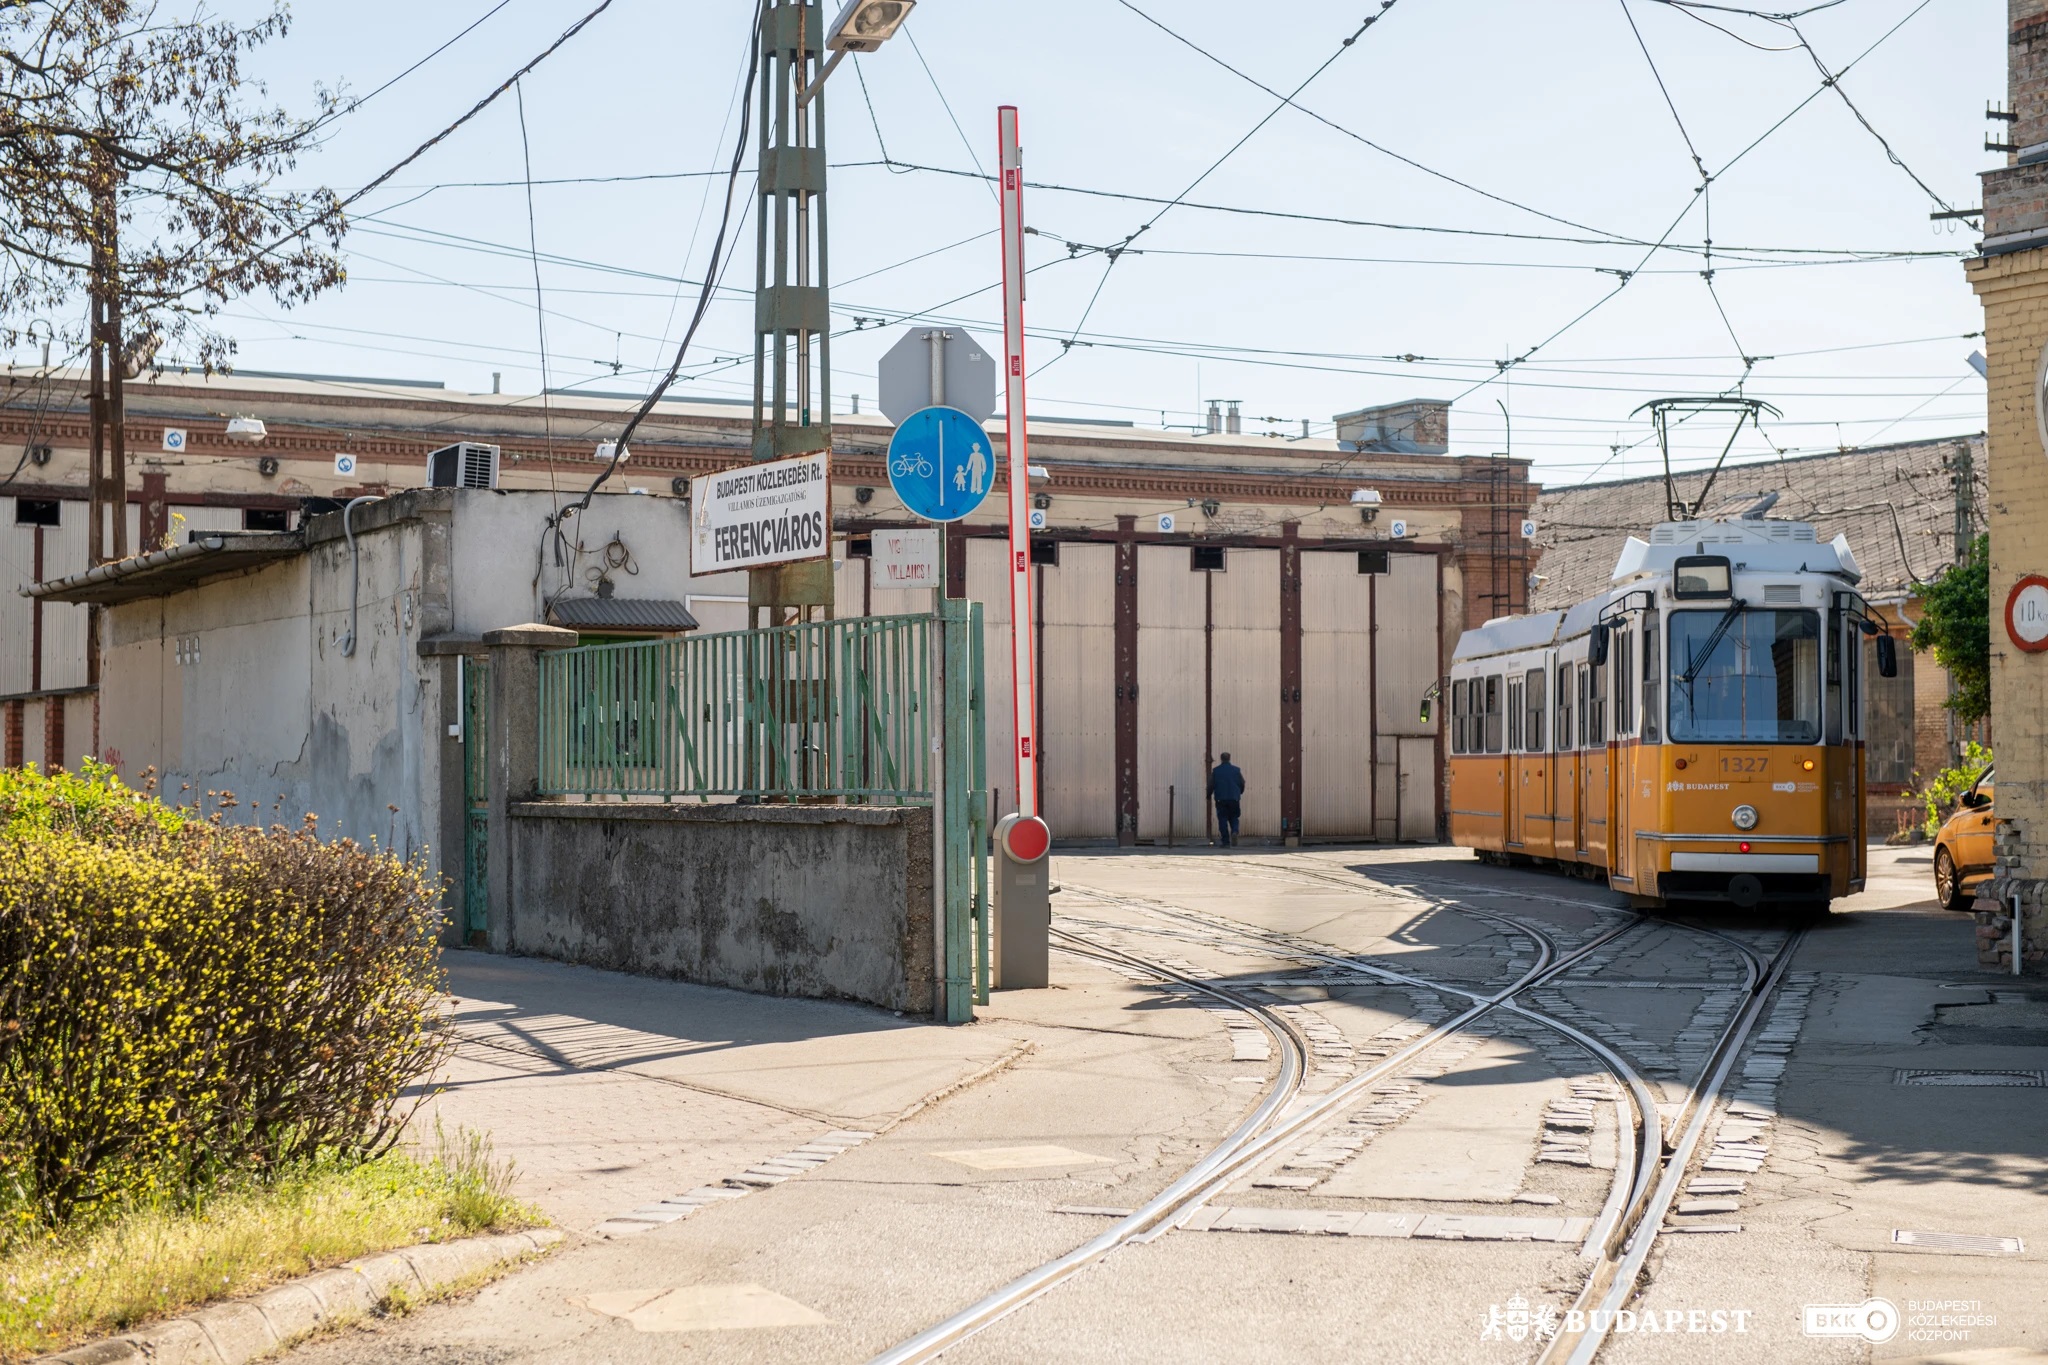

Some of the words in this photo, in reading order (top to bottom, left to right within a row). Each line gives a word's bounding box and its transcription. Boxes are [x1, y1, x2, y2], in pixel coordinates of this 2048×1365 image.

[266, 461, 273, 473] 2
[717, 475, 755, 499] BUDAPESTI
[757, 461, 809, 492] KÖZLEKEDÉSI
[811, 463, 822, 481] Rt.
[728, 498, 755, 512] VILLAMOS
[715, 508, 822, 562] FERENCVÁROS
[2021, 600, 2035, 622] 10
[1720, 757, 1769, 773] 1327
